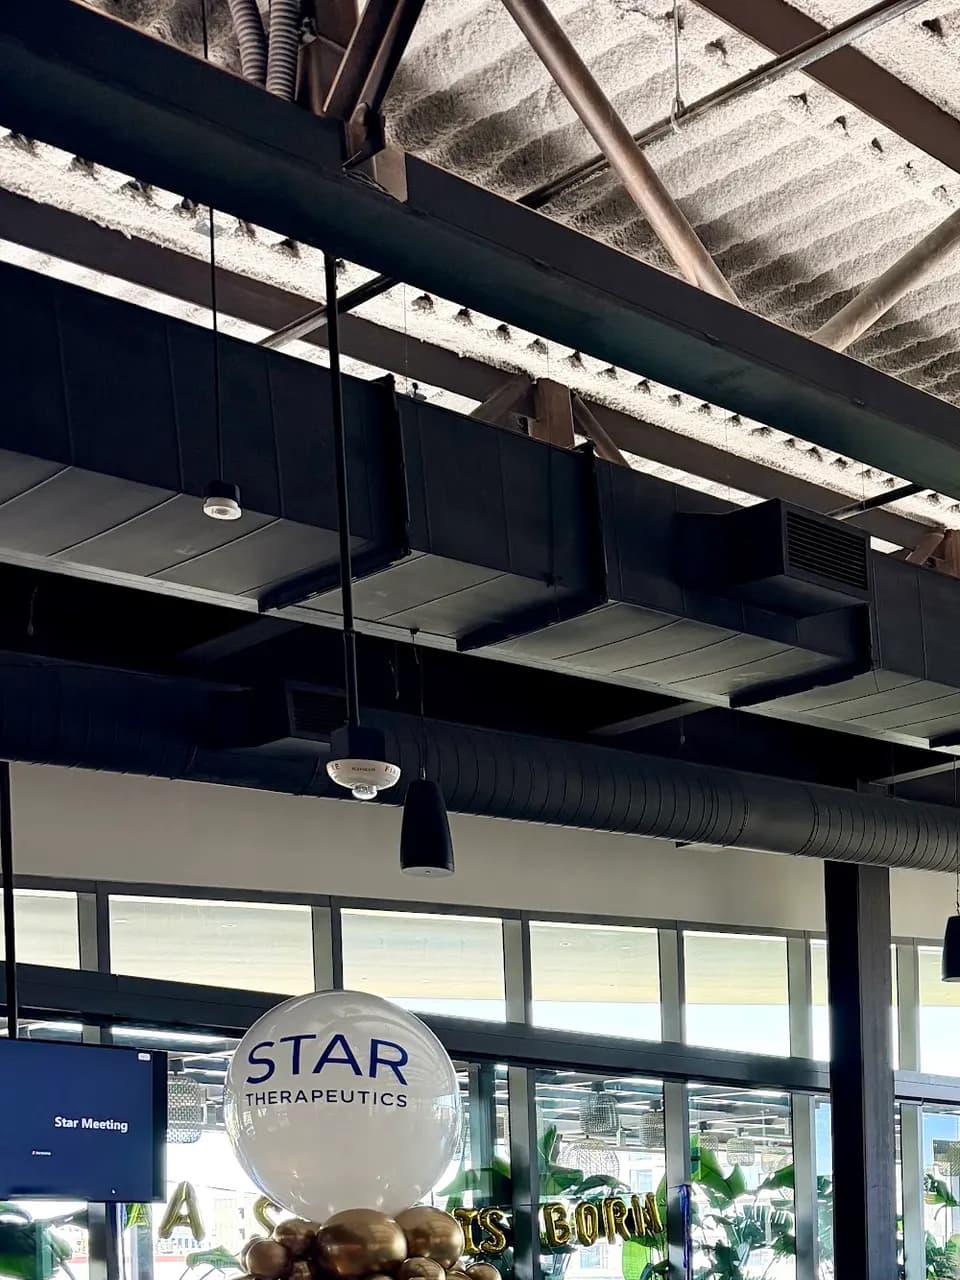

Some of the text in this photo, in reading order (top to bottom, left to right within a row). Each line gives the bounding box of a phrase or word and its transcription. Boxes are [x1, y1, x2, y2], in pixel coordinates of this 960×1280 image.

[246, 1033, 409, 1086] STAR
[246, 1089, 408, 1108] THERAPEUTICS
[54, 1116, 128, 1133] Star Meeting
[158, 1180, 206, 1241] A
[542, 1191, 664, 1247] BORN
